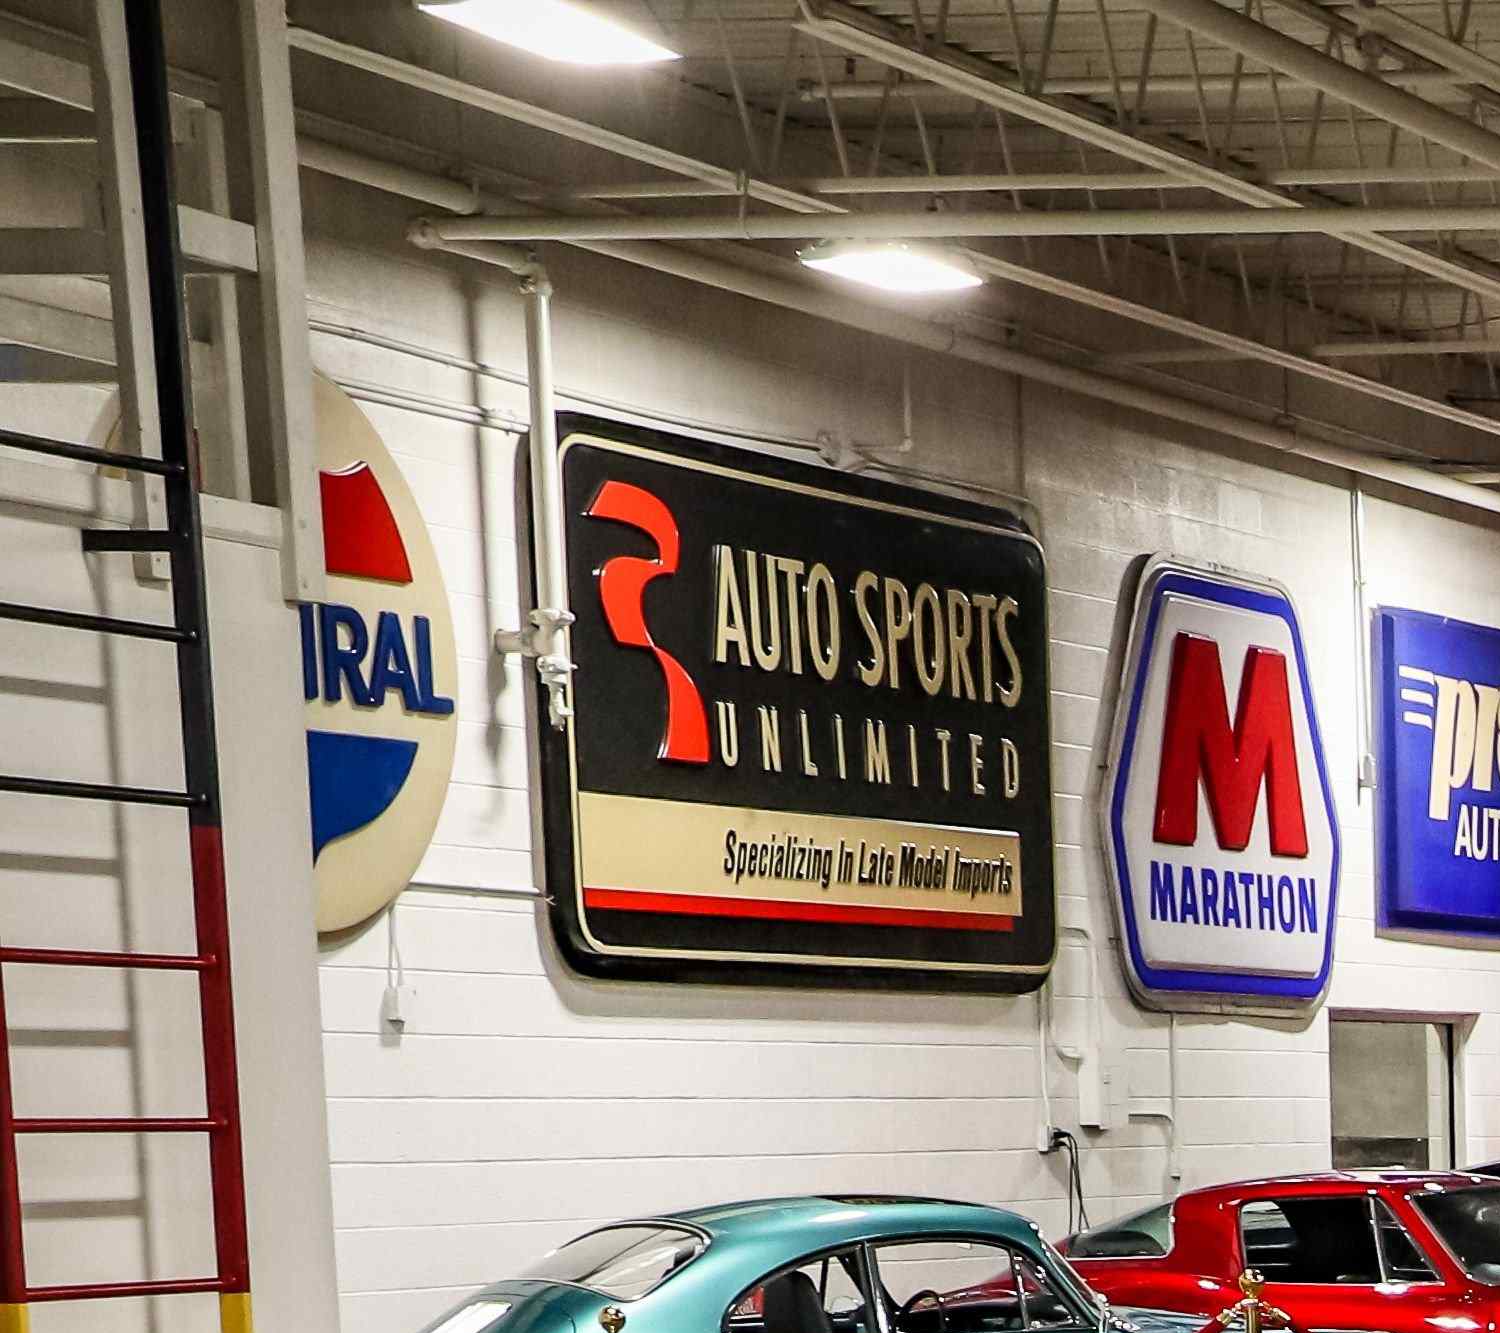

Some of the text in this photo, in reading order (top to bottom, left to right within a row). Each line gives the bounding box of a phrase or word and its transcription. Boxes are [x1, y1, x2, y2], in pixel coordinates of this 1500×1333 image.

[712, 544, 1022, 708] AUTO SPORTS
[716, 700, 1020, 799] UNLIMITED
[1153, 632, 1309, 859] M
[724, 829, 1012, 898] Specializing In Late Model Imports
[1150, 860, 1318, 935] MARATHON
